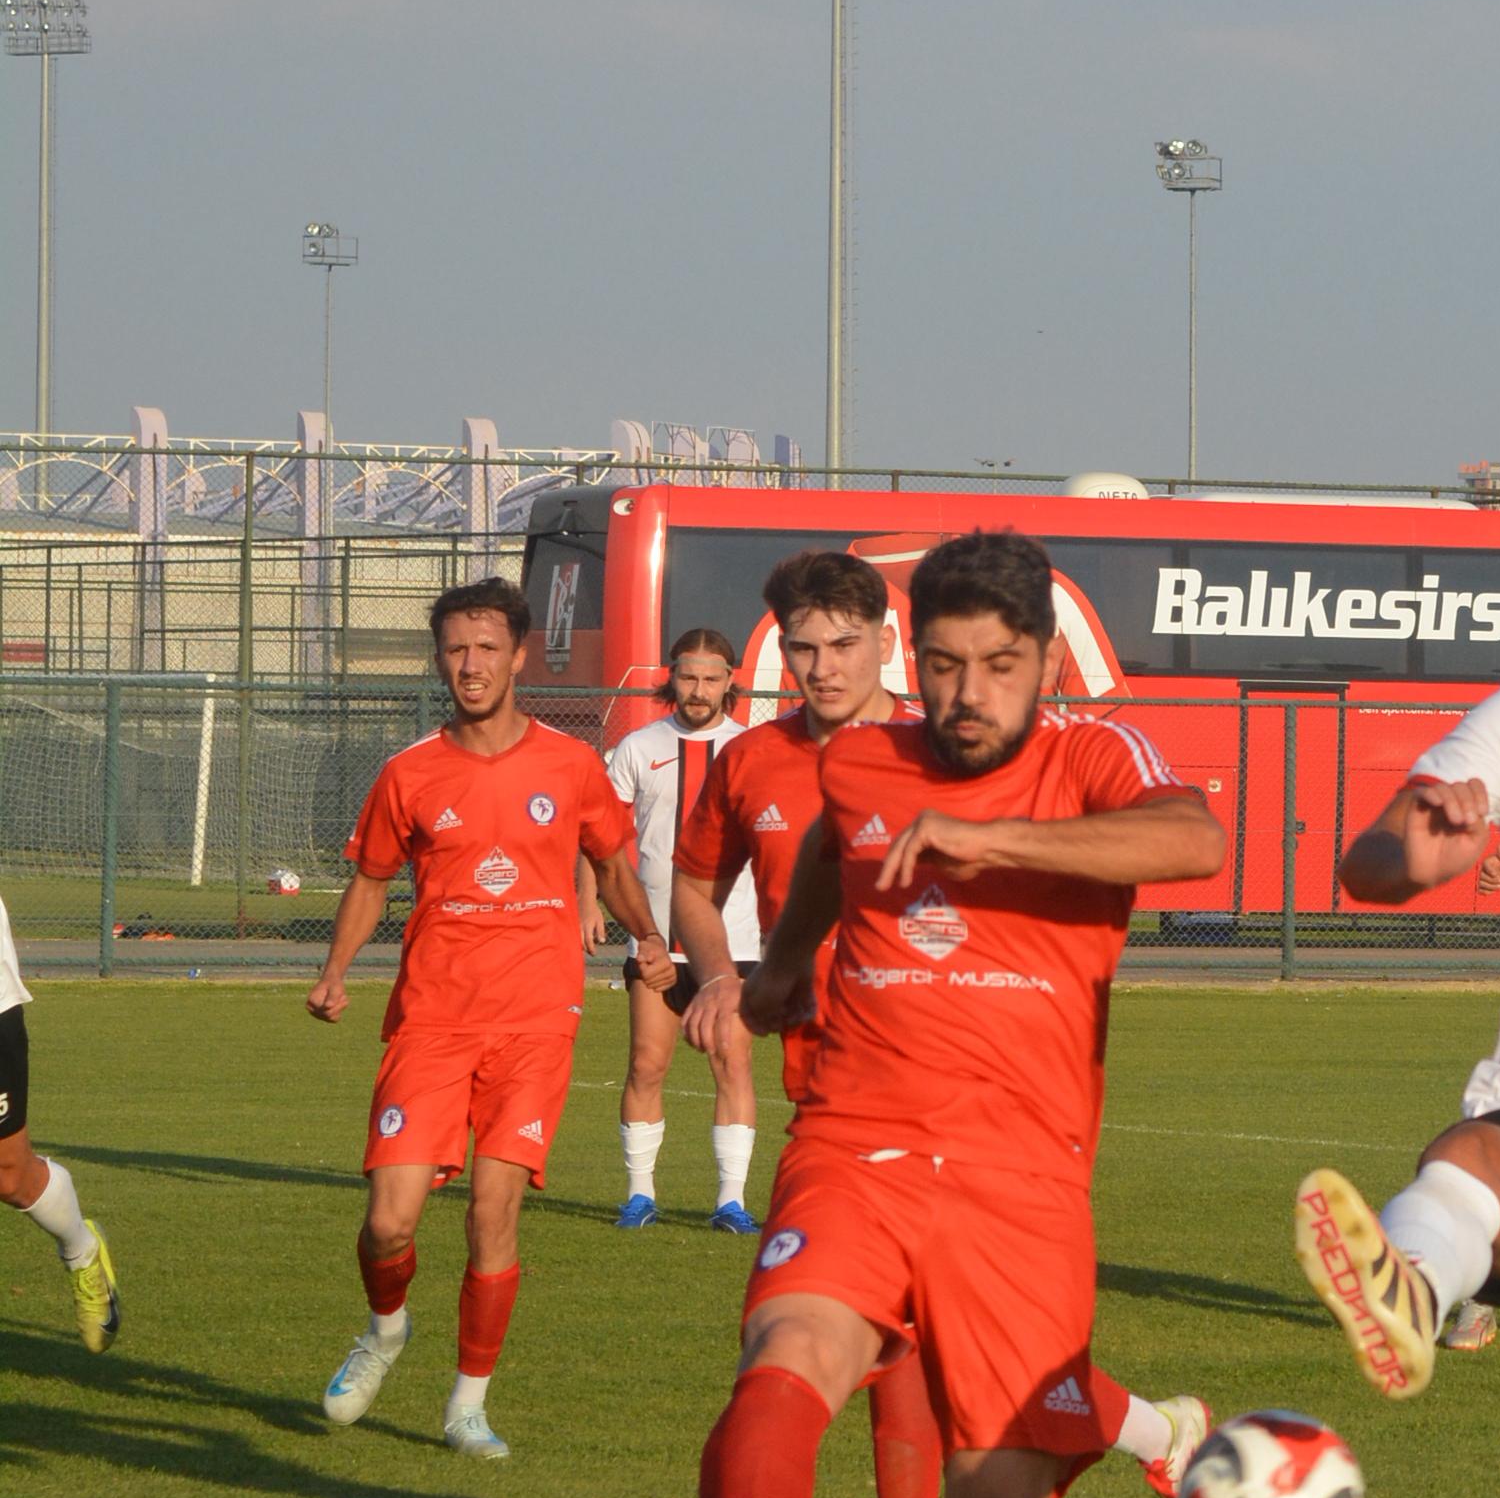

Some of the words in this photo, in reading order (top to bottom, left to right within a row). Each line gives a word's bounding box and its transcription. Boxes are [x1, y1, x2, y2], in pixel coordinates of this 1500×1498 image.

[753, 821, 788, 832] adidas
[1302, 1188, 1409, 1396] PREDATOR
[1043, 1397, 1090, 1417] adidas
